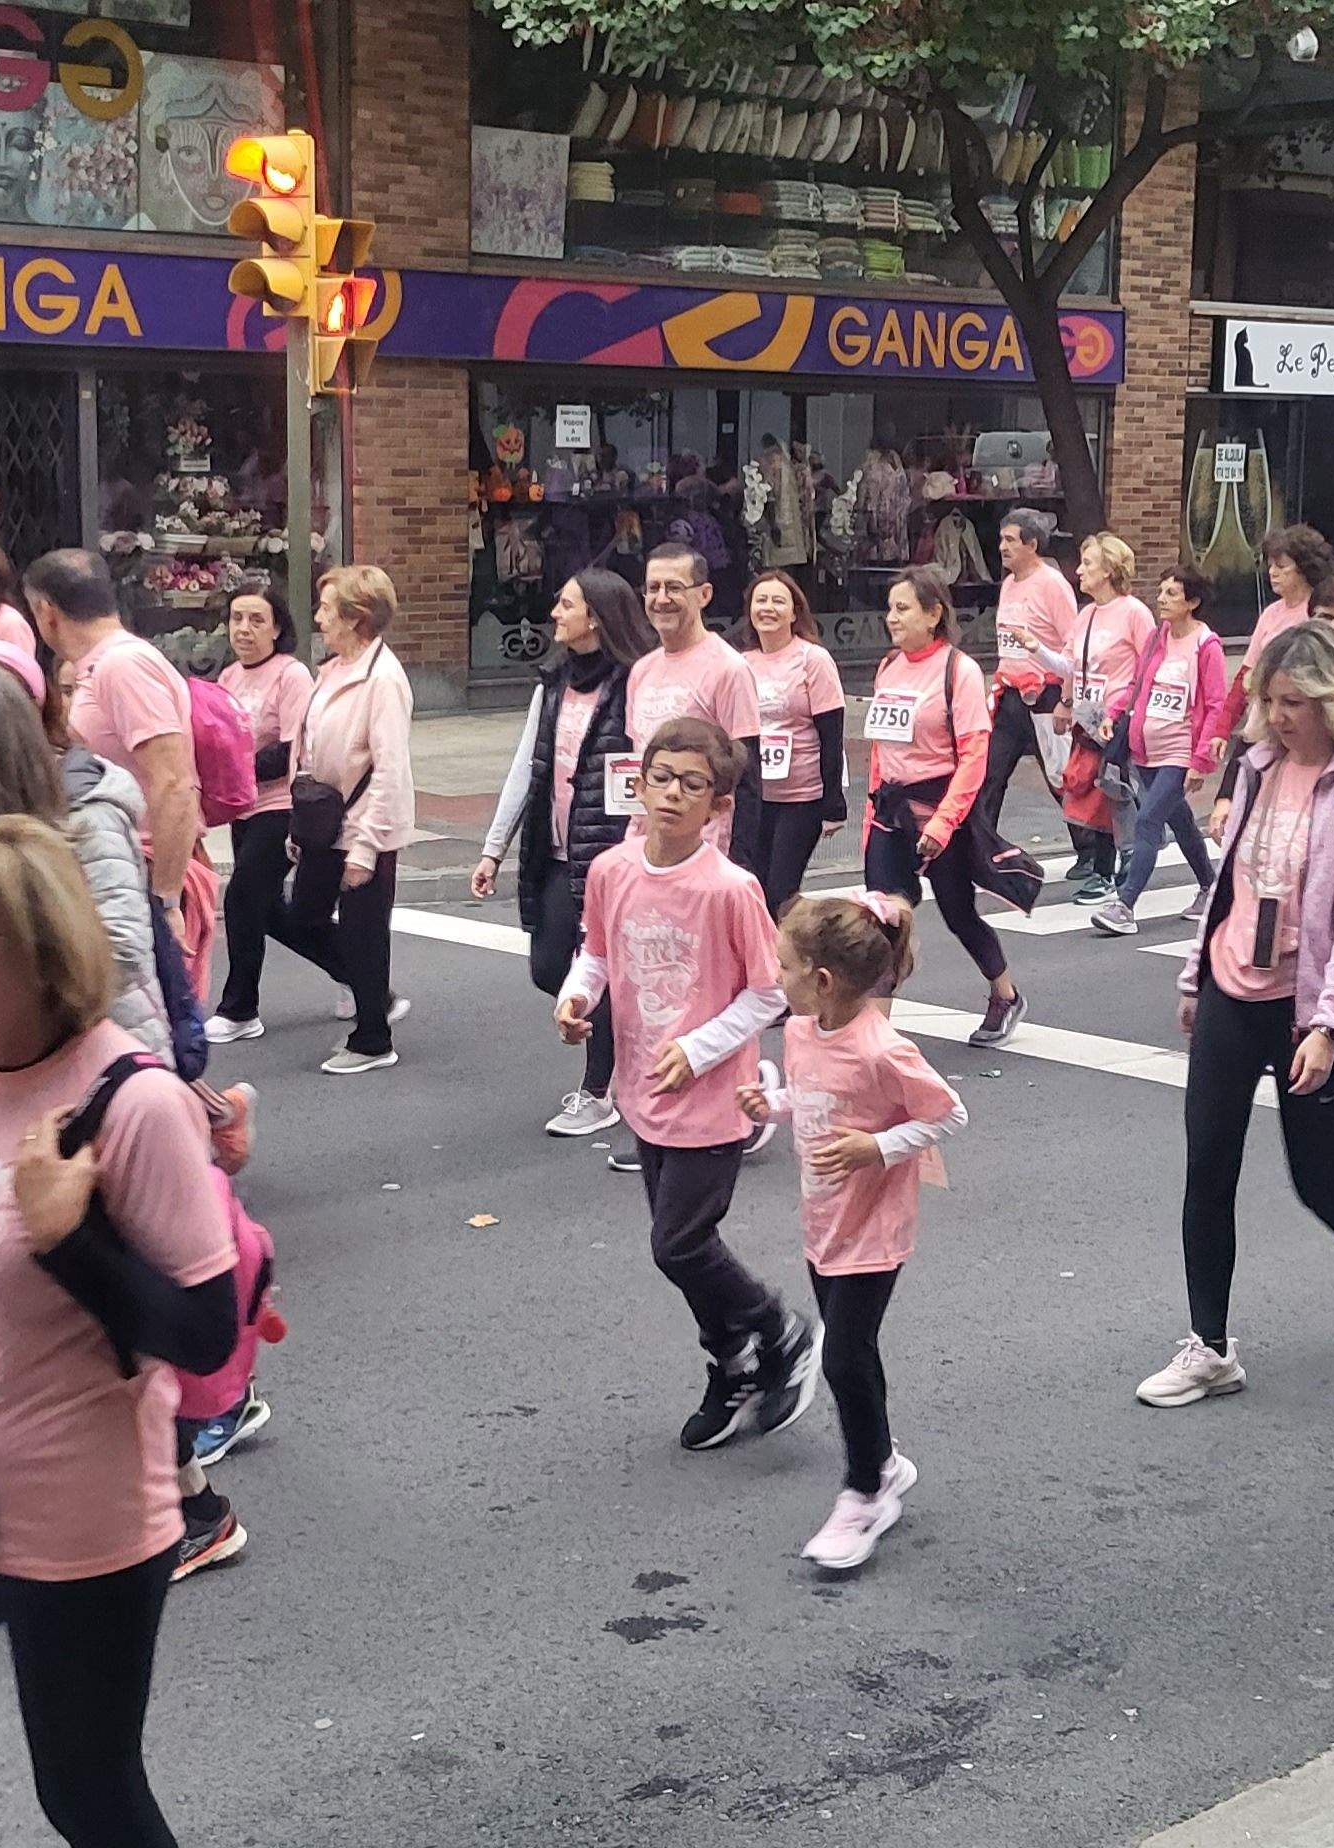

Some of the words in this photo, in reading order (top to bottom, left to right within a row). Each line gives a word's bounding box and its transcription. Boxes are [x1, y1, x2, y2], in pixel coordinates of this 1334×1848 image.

[828, 306, 1025, 372] GANGA
[1276, 344, 1304, 375] Le
[1152, 692, 1183, 711] 992
[869, 706, 910, 727] 3750
